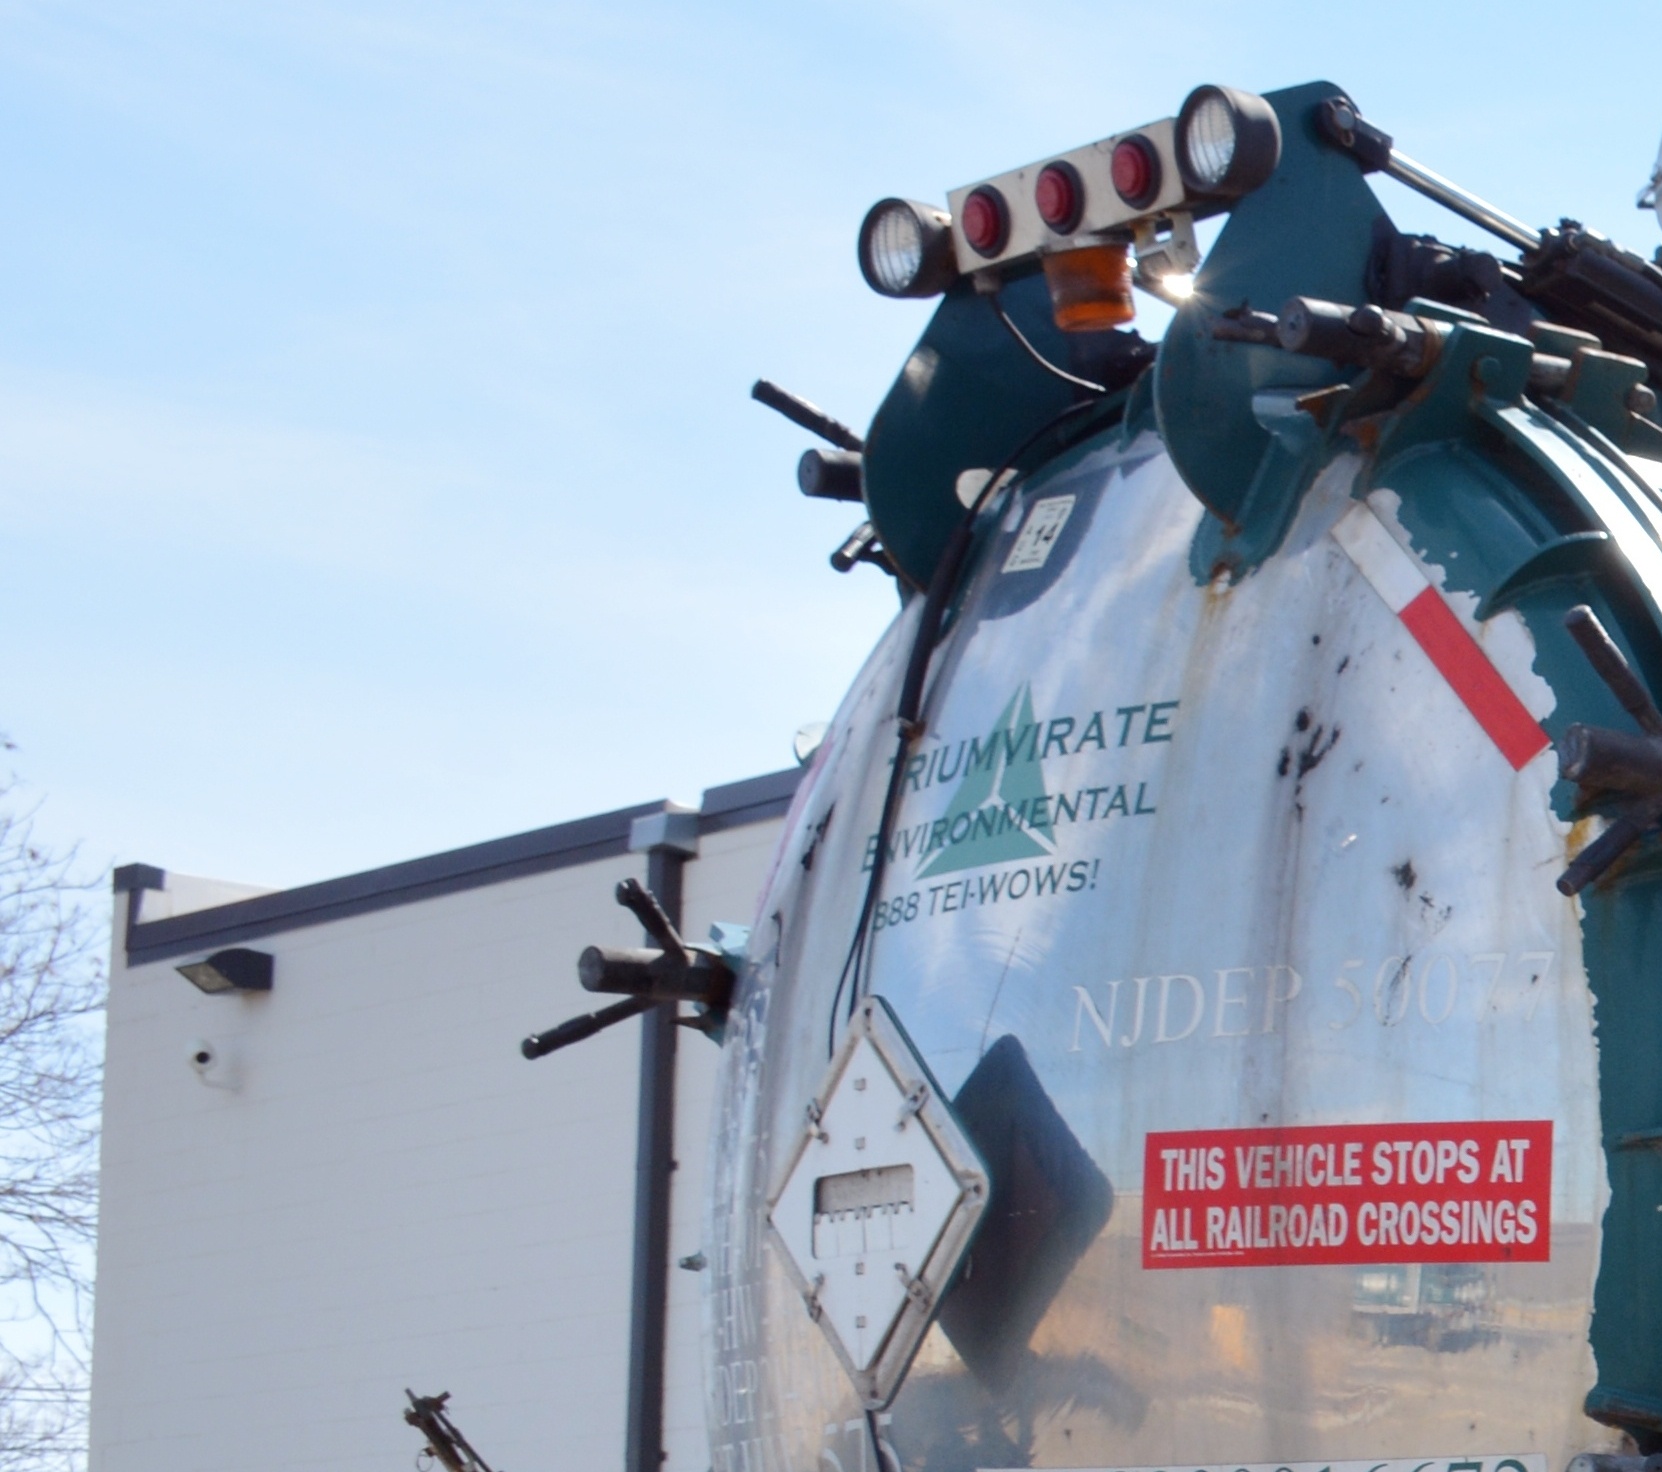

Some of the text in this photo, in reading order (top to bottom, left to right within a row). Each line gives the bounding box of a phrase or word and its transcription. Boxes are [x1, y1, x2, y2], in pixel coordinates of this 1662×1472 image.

[888, 700, 1180, 796] RIUMVIRATE
[872, 892, 921, 932] 888
[1068, 950, 1556, 1053] NJDEP 50077
[1161, 1137, 1529, 1191] THIS VEHICLE STOPS AT
[1151, 1198, 1538, 1252] ALL RAILROAD CROSSINGS
